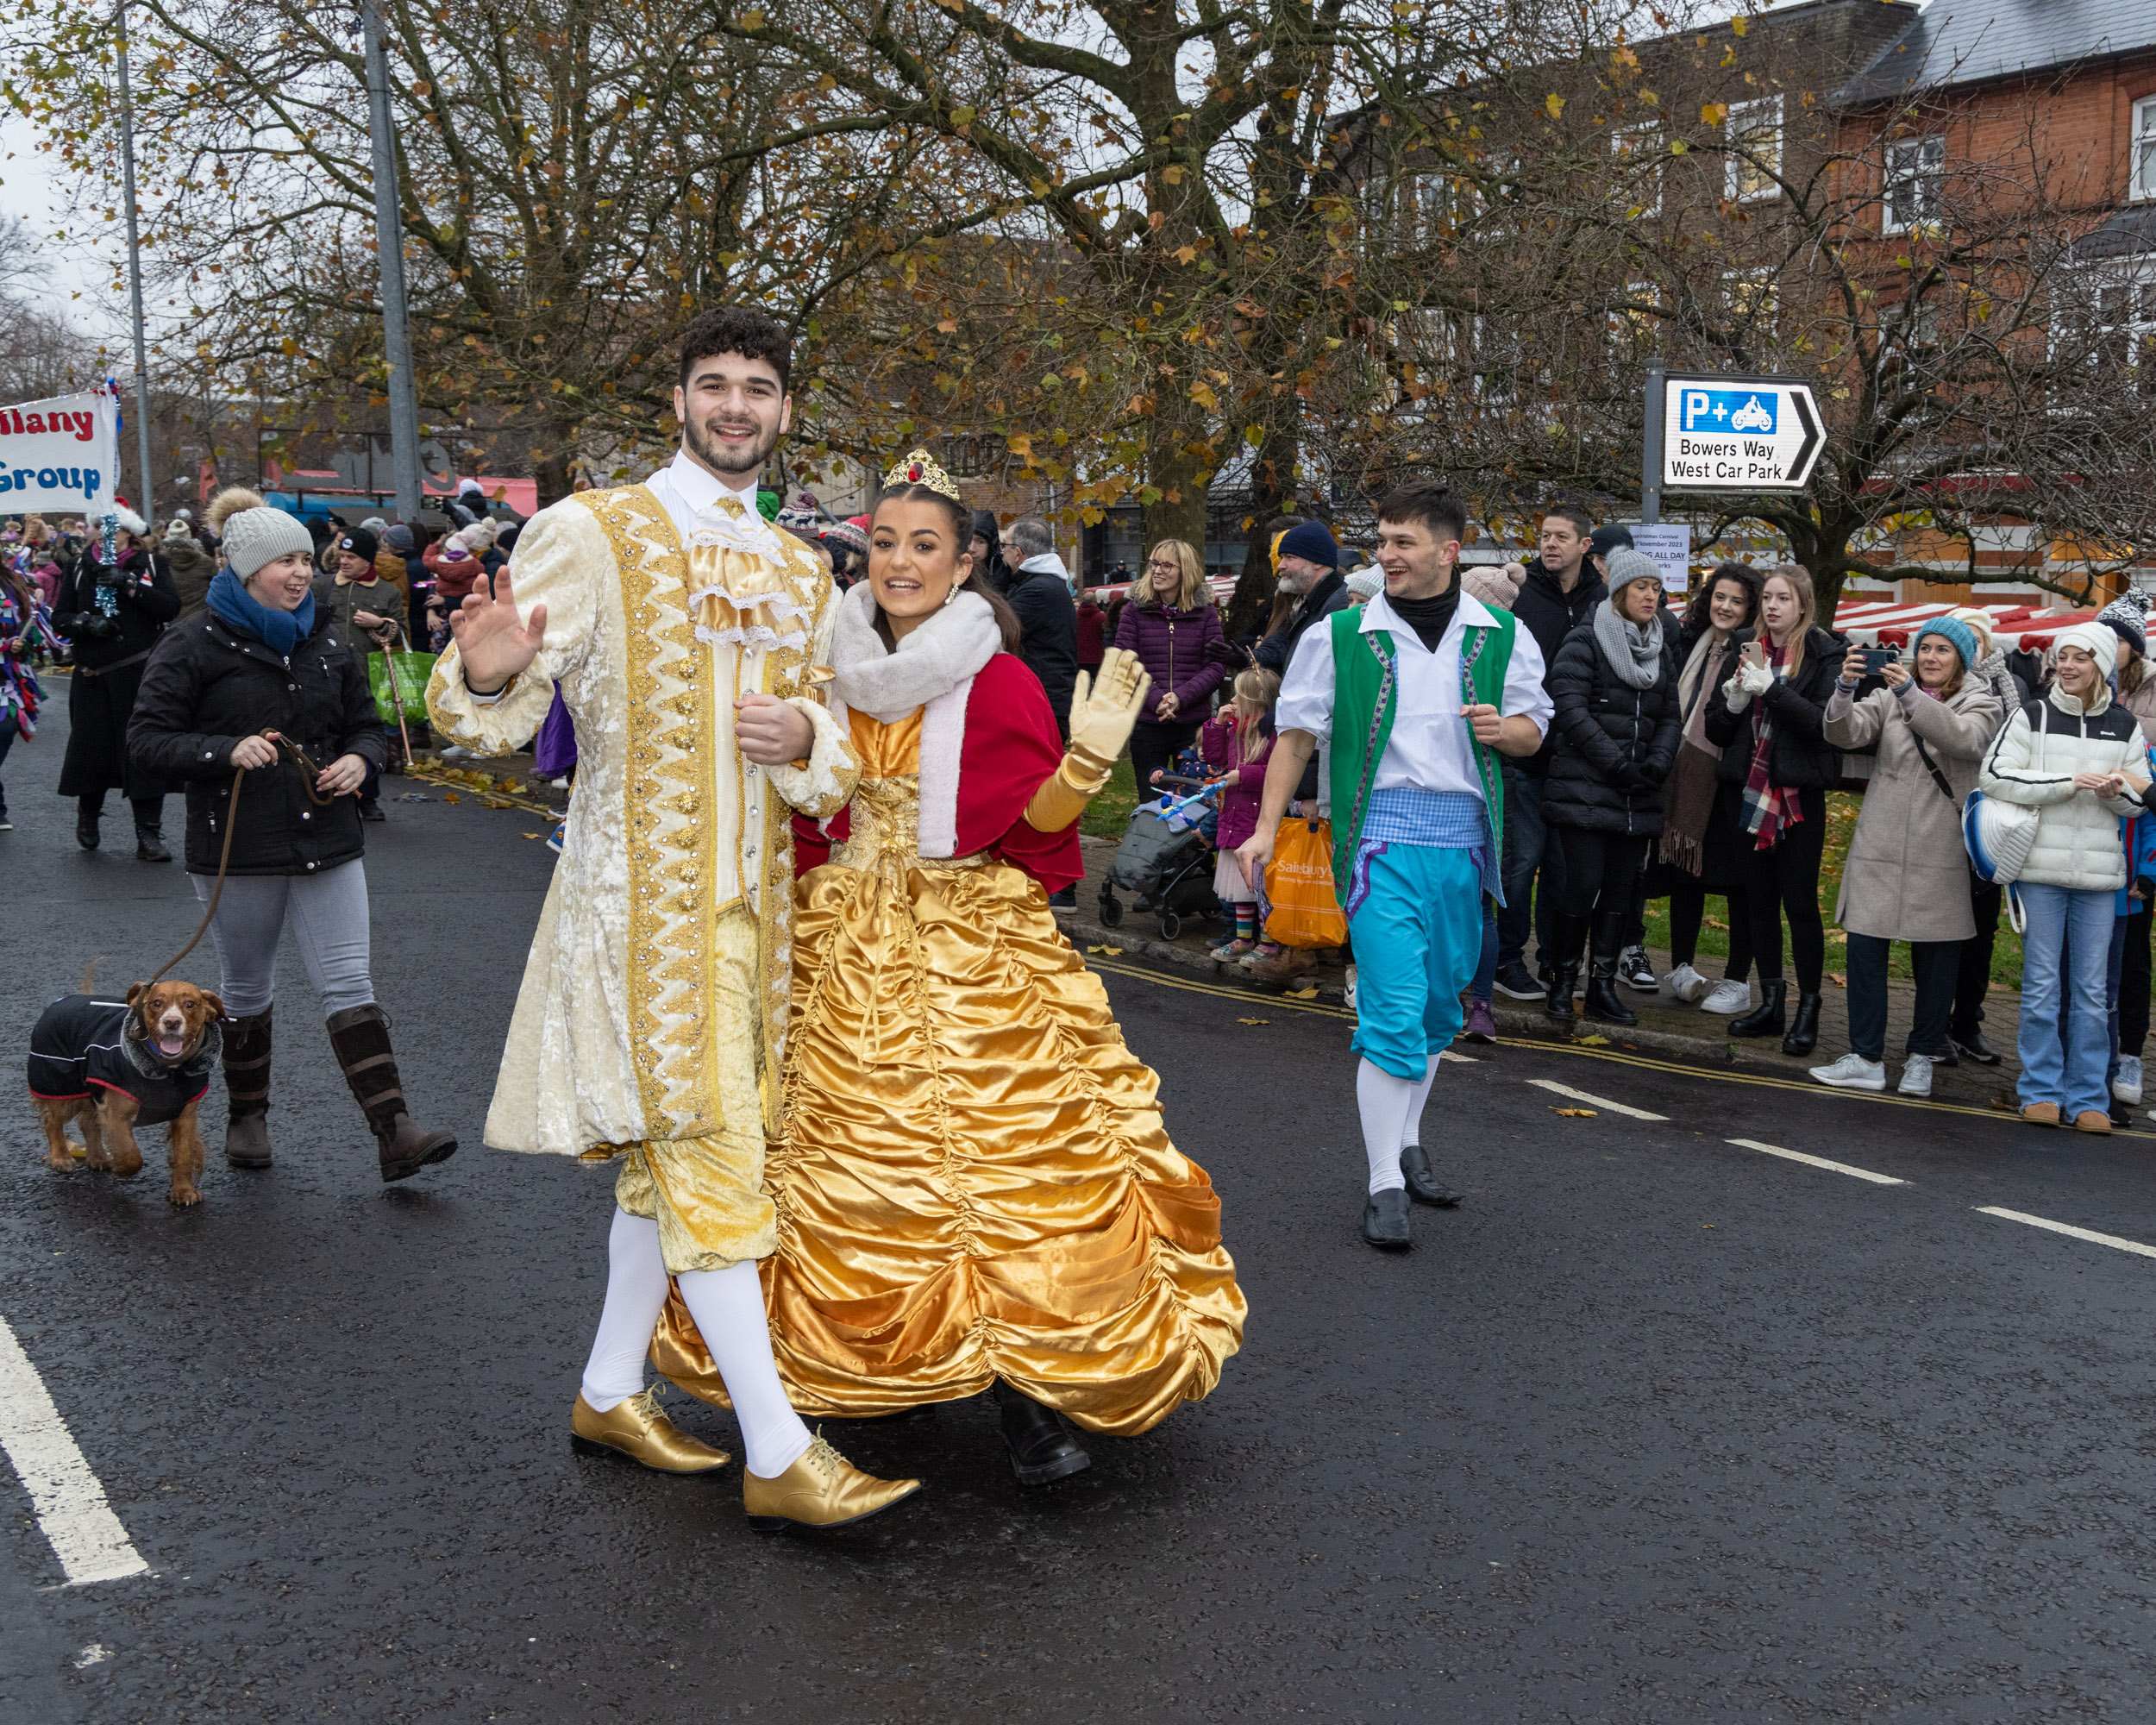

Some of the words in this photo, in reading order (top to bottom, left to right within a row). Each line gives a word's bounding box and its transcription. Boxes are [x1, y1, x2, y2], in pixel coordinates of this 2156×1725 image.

[1681, 439, 1737, 456] Bowers
[1744, 441, 1774, 461] Way
[1672, 461, 1710, 478] West
[1716, 462, 1743, 479] Car
[1748, 463, 1783, 480] Park
